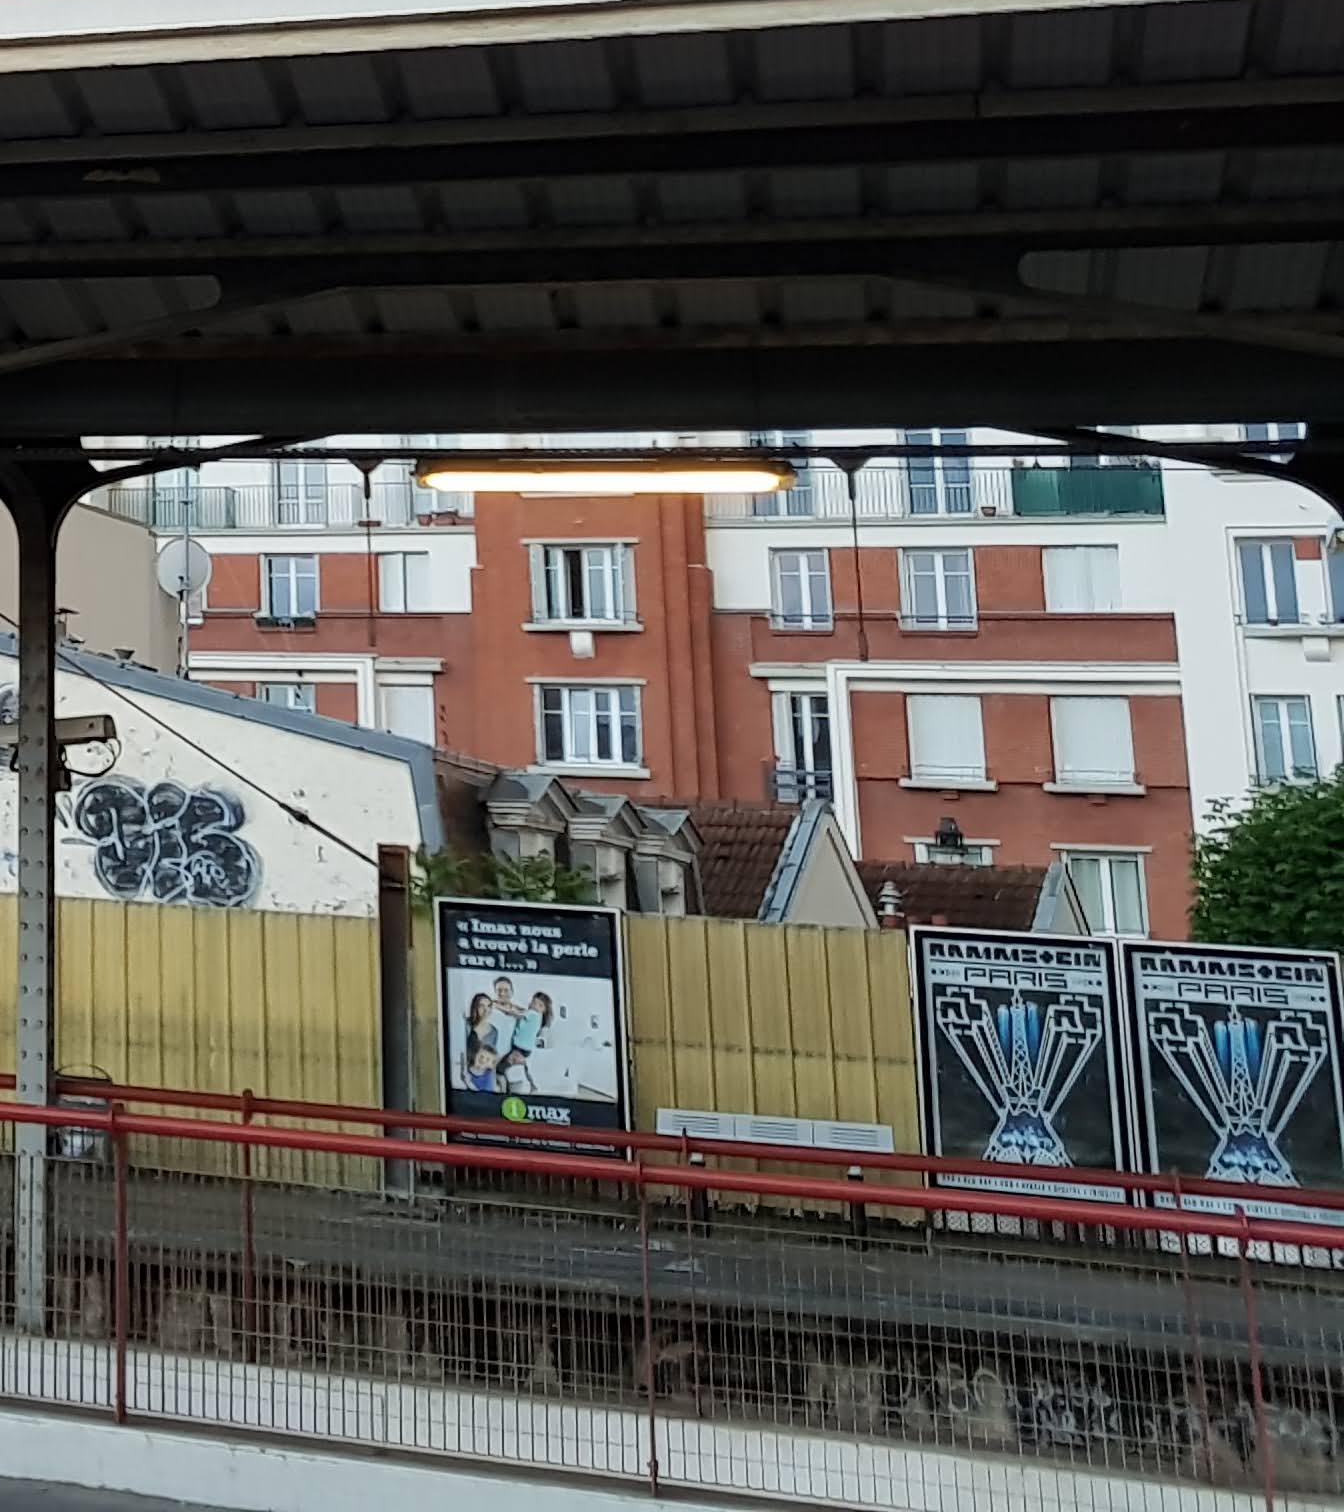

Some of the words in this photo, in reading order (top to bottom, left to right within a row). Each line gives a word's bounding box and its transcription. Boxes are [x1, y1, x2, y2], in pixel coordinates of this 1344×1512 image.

[471, 918, 517, 936] Imax
[519, 925, 562, 939] nous
[472, 937, 528, 954] trouvé
[531, 940, 549, 955] la
[551, 942, 599, 959] perle
[929, 942, 1101, 968] RAMMSTEIN
[459, 954, 495, 968] rare
[1140, 957, 1324, 983] RAMMSTEIN
[964, 967, 1068, 989] PARIS
[1178, 982, 1289, 1005] PARIS
